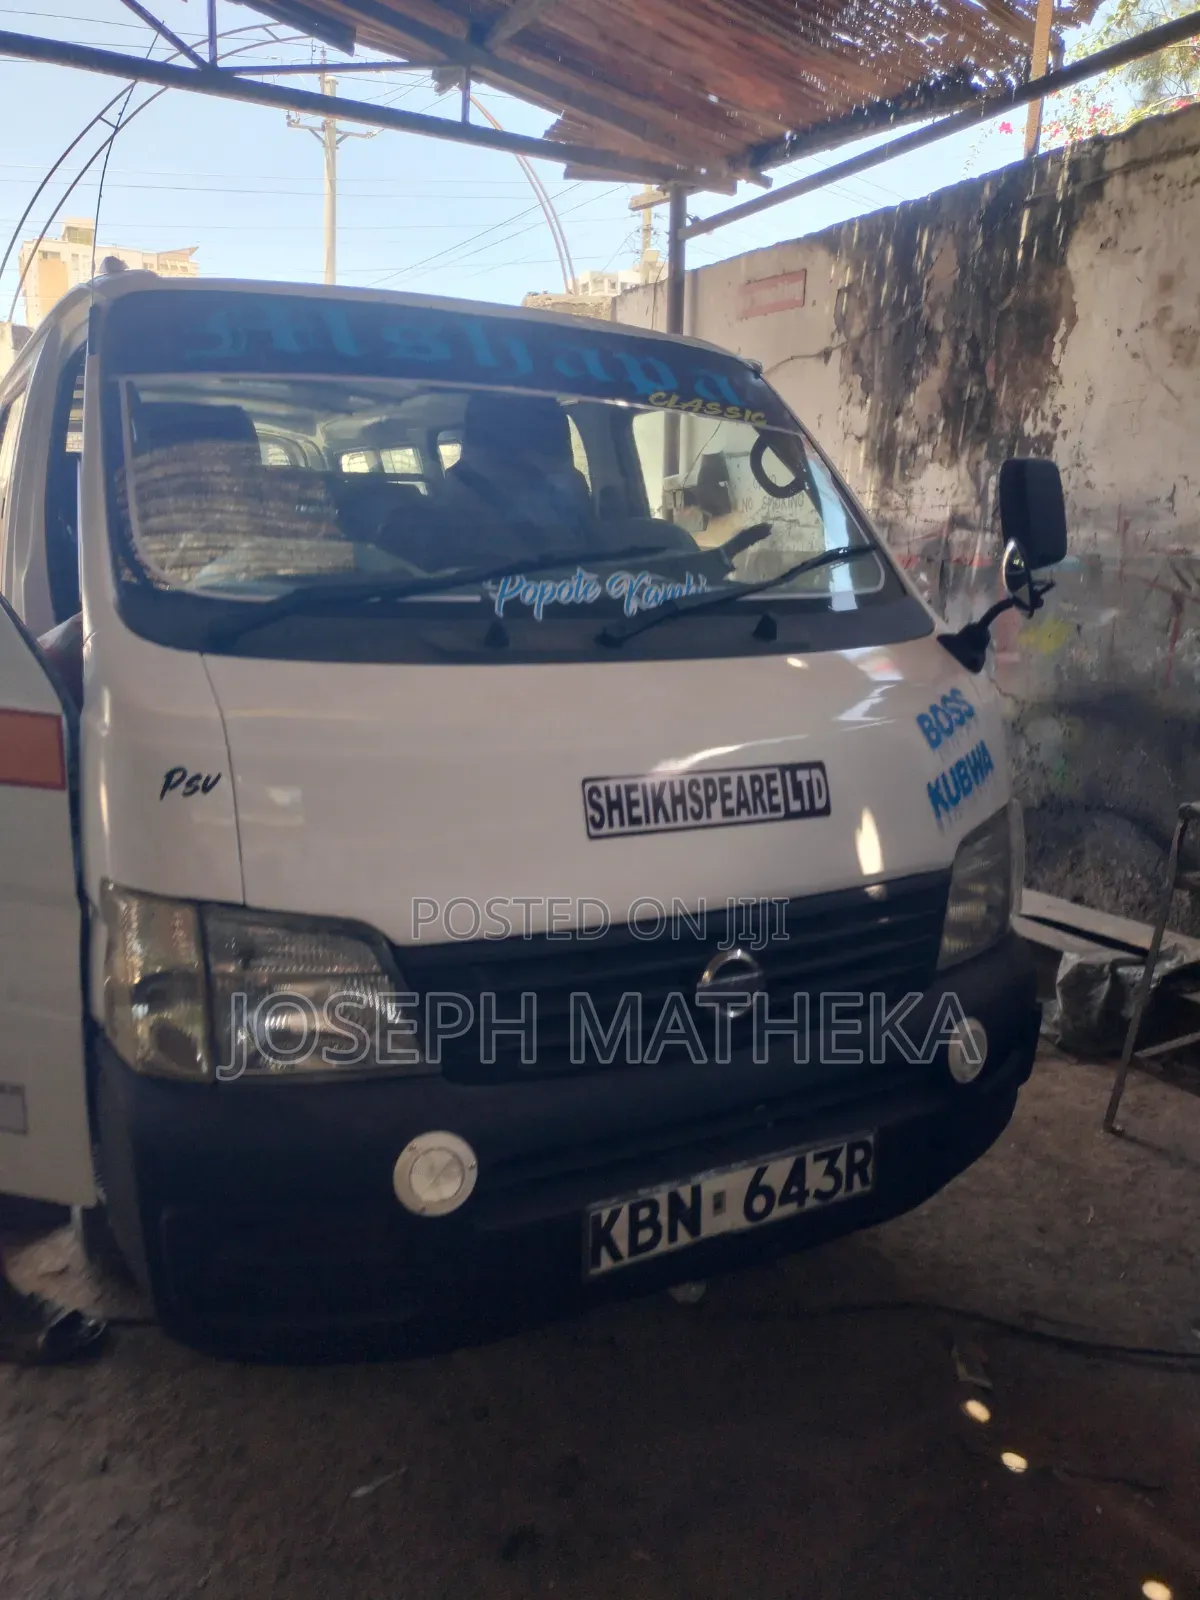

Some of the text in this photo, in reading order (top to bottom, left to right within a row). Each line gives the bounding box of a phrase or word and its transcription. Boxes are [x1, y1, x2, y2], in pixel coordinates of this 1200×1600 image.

[649, 391, 767, 427] CLASSIC
[482, 565, 601, 621] Popote
[916, 688, 975, 750] BOSS
[587, 768, 828, 830] SHEIKHSPEARE LTD
[927, 740, 994, 822] KUBWA
[589, 1139, 874, 1269] KBN 643R
